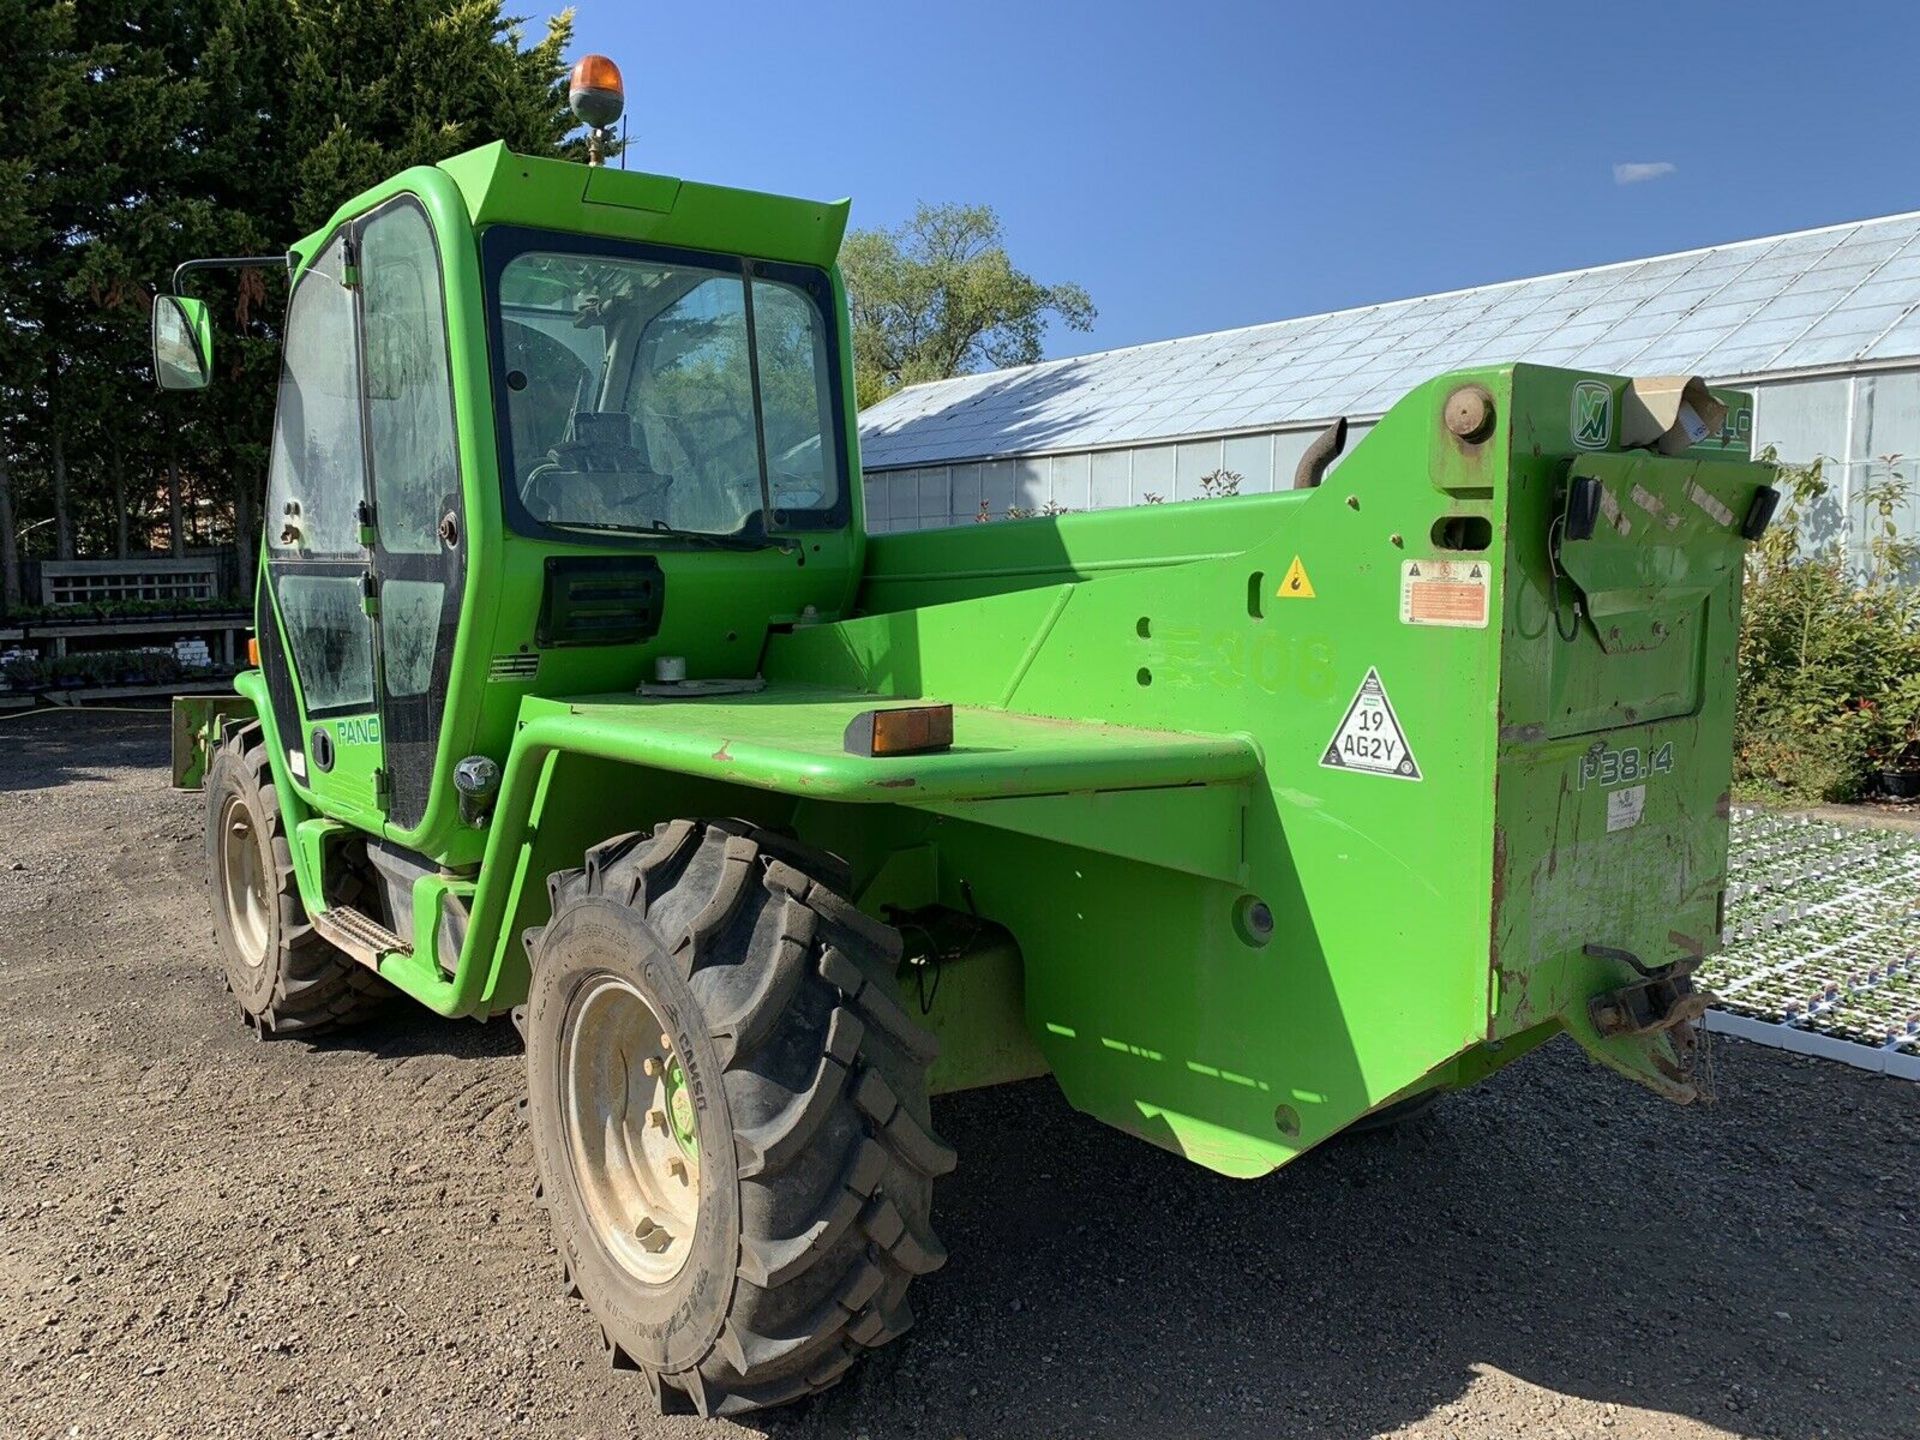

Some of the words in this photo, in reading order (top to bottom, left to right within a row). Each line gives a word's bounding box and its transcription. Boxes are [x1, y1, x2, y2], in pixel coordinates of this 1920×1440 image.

[1359, 709, 1384, 731] 19
[1343, 734, 1396, 761] AG2Y
[1577, 741, 1674, 791] P38.14
